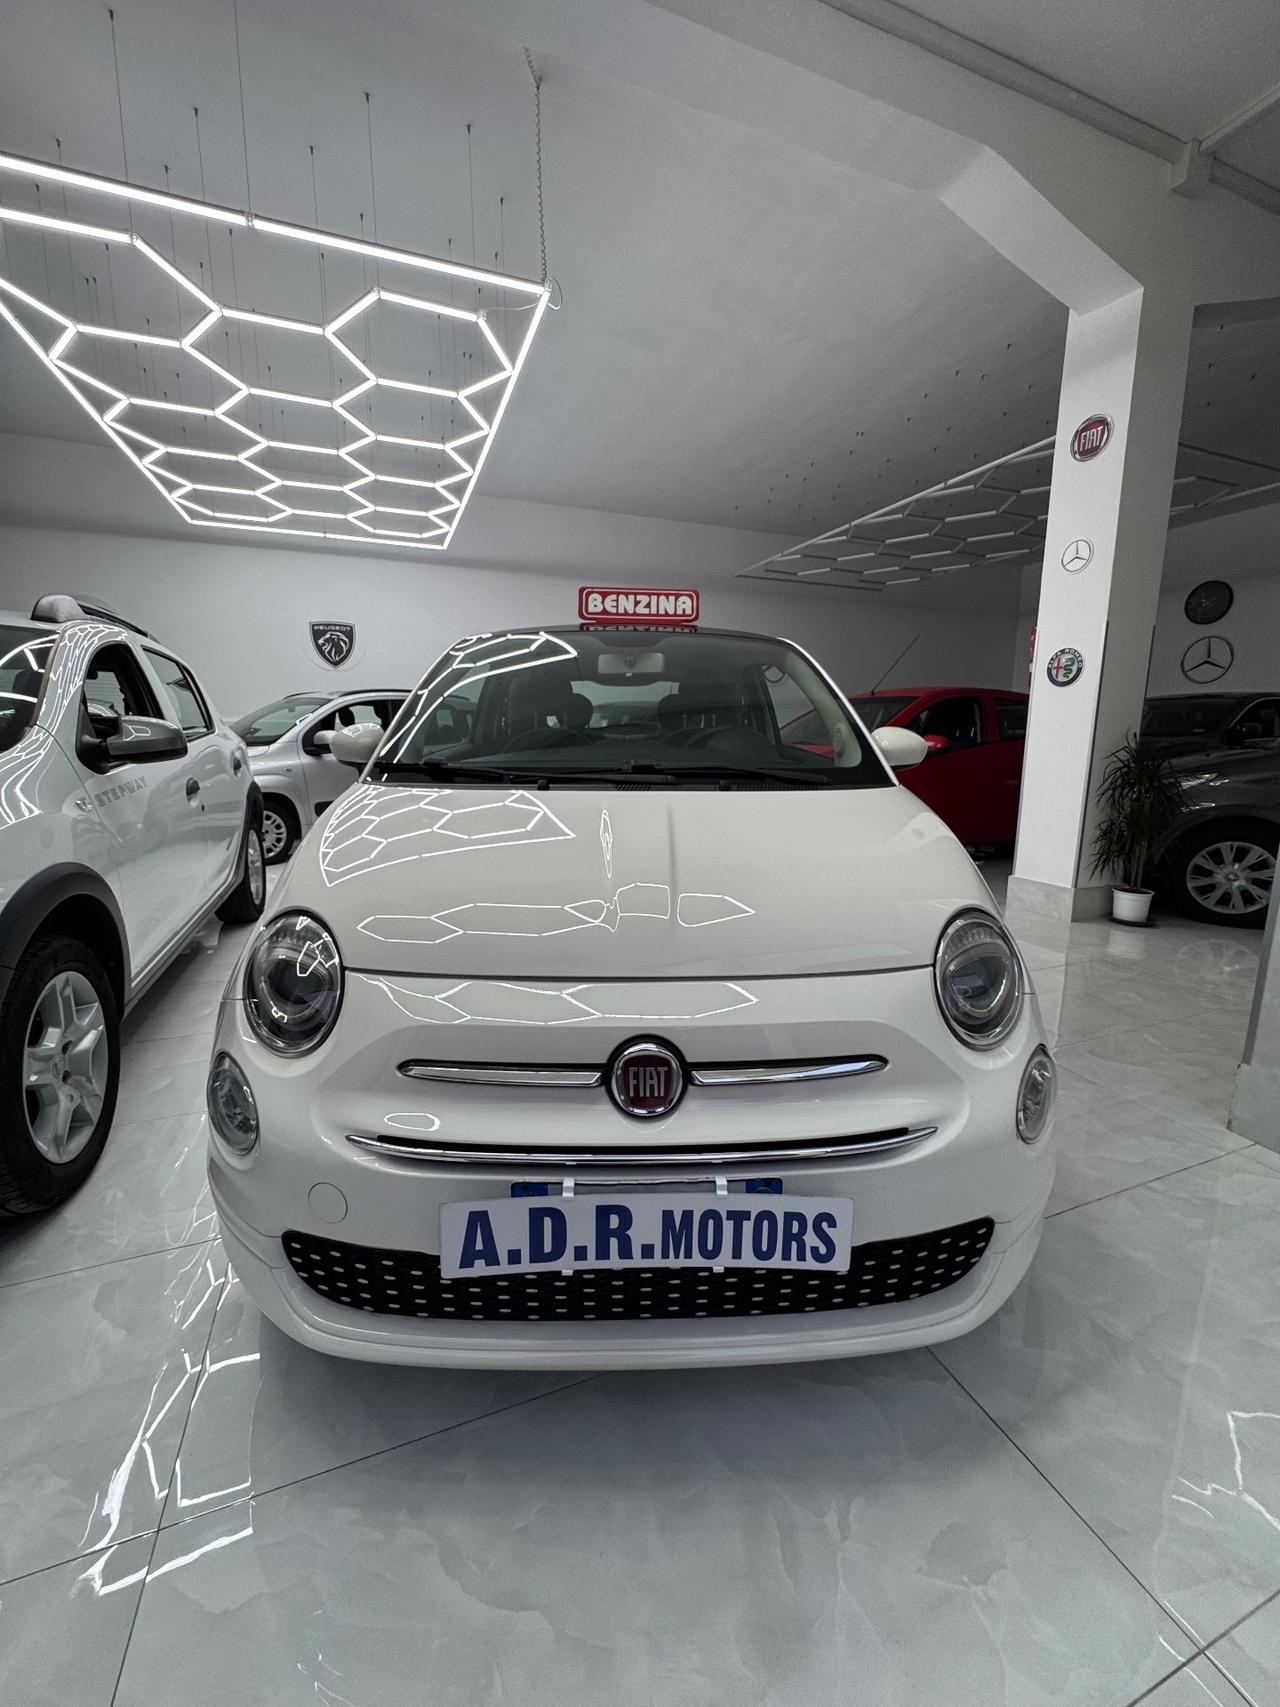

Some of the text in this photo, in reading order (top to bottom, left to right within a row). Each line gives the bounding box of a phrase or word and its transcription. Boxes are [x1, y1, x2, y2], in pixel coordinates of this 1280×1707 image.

[1080, 425, 1104, 451] FIAT
[588, 593, 692, 615] BENZINA
[94, 775, 147, 807] STEPWAY
[628, 1066, 669, 1098] FIAT
